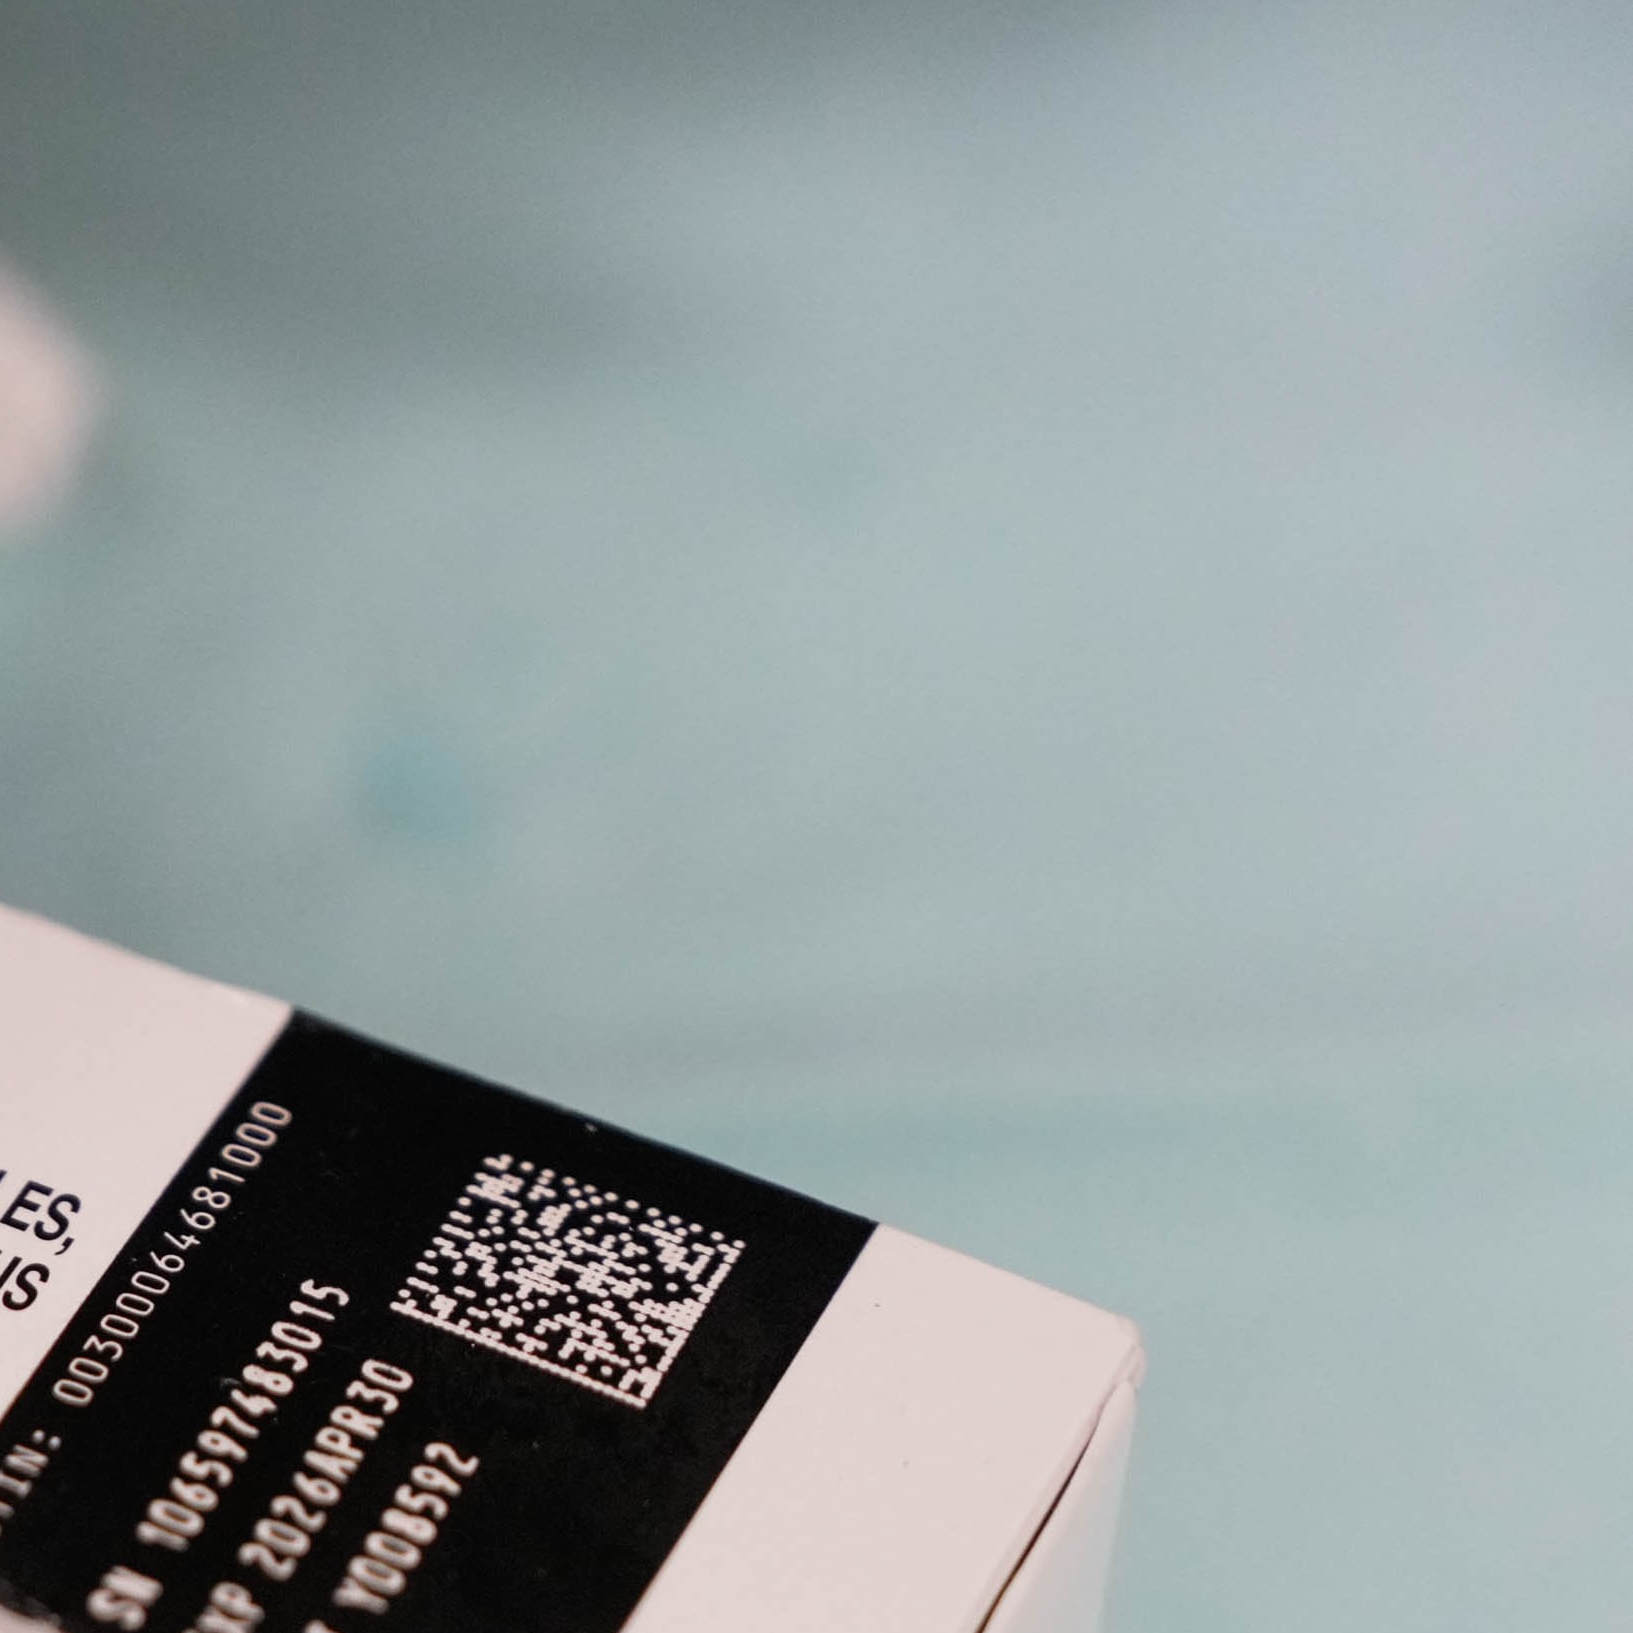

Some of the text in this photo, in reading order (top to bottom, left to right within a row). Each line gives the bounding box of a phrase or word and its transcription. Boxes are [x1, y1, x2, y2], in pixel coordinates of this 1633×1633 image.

[52, 1100, 293, 1408] 00300064681000
[85, 1278, 350, 1632] SN 106597483015
[237, 1358, 414, 1582] 2026APR30
